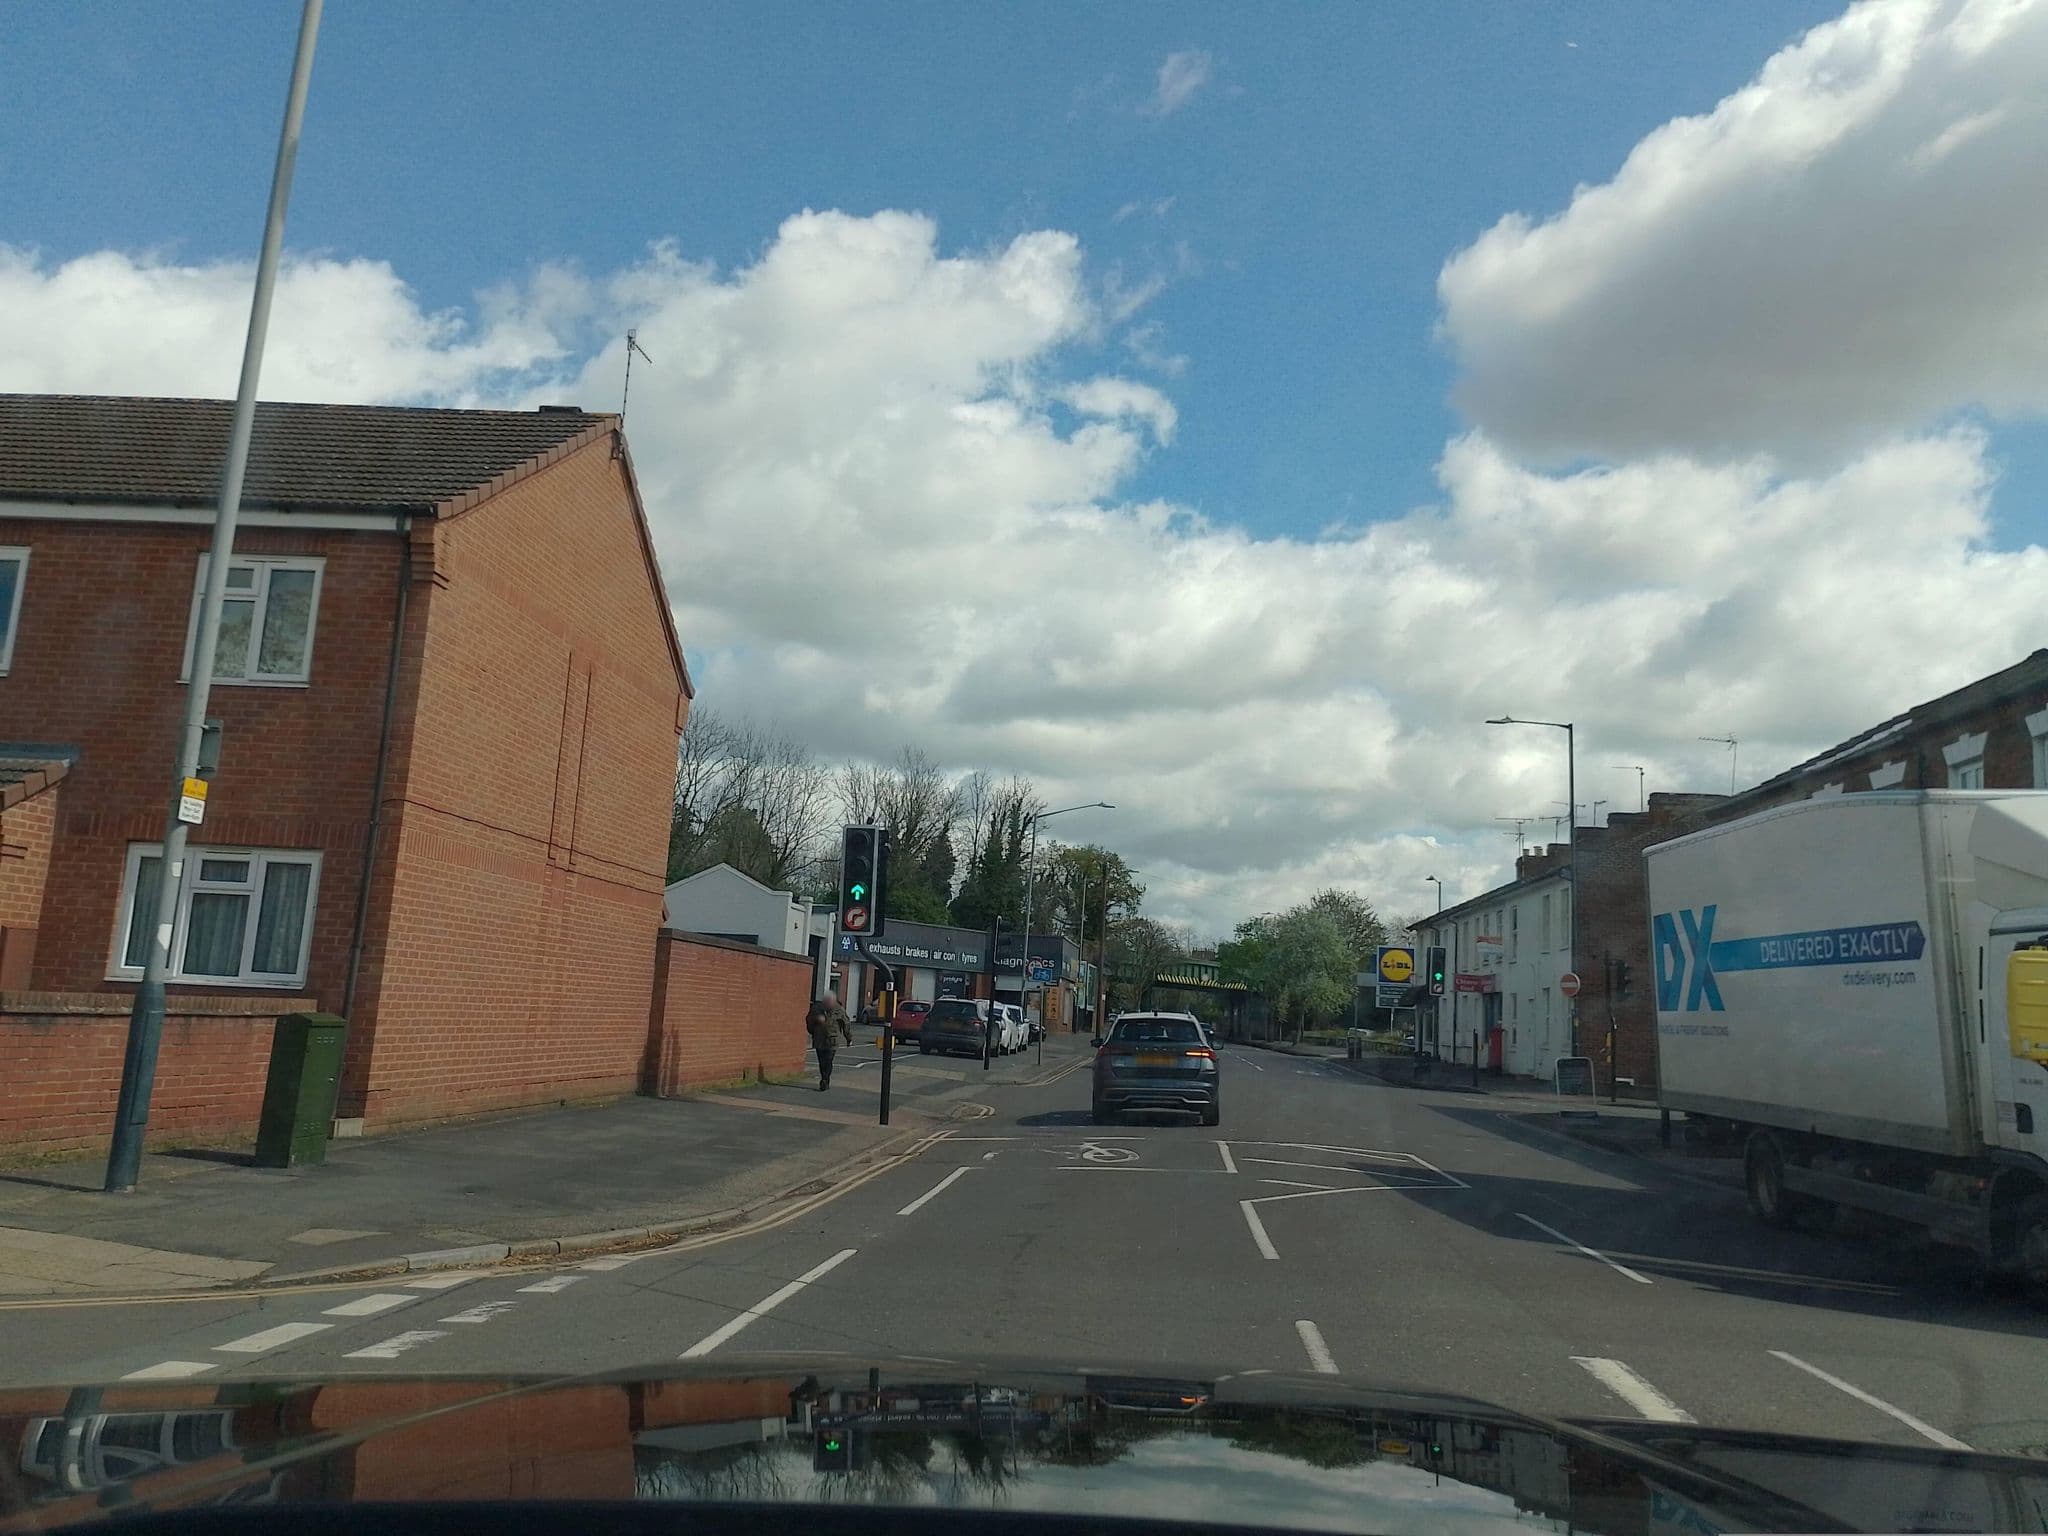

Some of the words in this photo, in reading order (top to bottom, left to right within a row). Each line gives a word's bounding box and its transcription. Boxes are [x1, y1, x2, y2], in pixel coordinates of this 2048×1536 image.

[869, 943, 901, 955] exhausts
[905, 946, 929, 959] brakes
[933, 949, 942, 960] air
[943, 952, 956, 961] con
[962, 953, 977, 965] tyres
[1653, 904, 1726, 1012] DX
[1760, 935, 1834, 963] DELIVERED
[1843, 970, 1916, 987] dxdelivery.com
